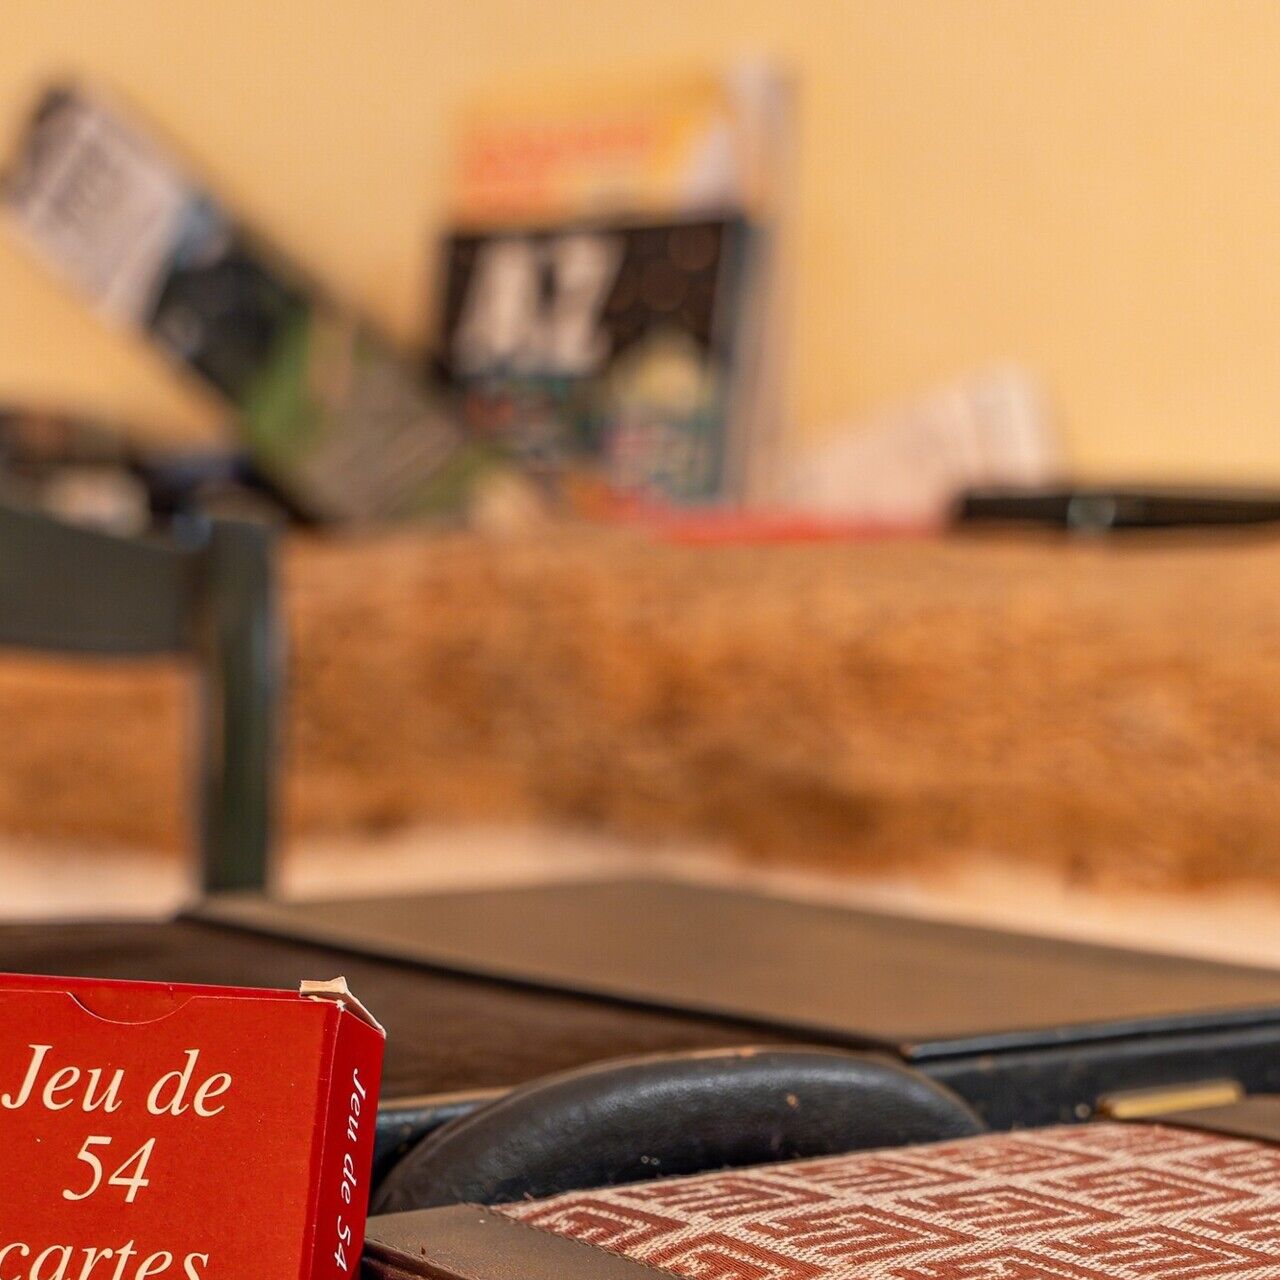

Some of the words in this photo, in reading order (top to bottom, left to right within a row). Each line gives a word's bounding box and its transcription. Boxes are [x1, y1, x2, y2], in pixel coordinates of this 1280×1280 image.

[2, 1044, 125, 1113] Jeu
[147, 1049, 232, 1117] de
[347, 1068, 367, 1143] Jeu
[62, 1135, 156, 1203] 54
[341, 1152, 359, 1205] de
[333, 1214, 352, 1272] 54
